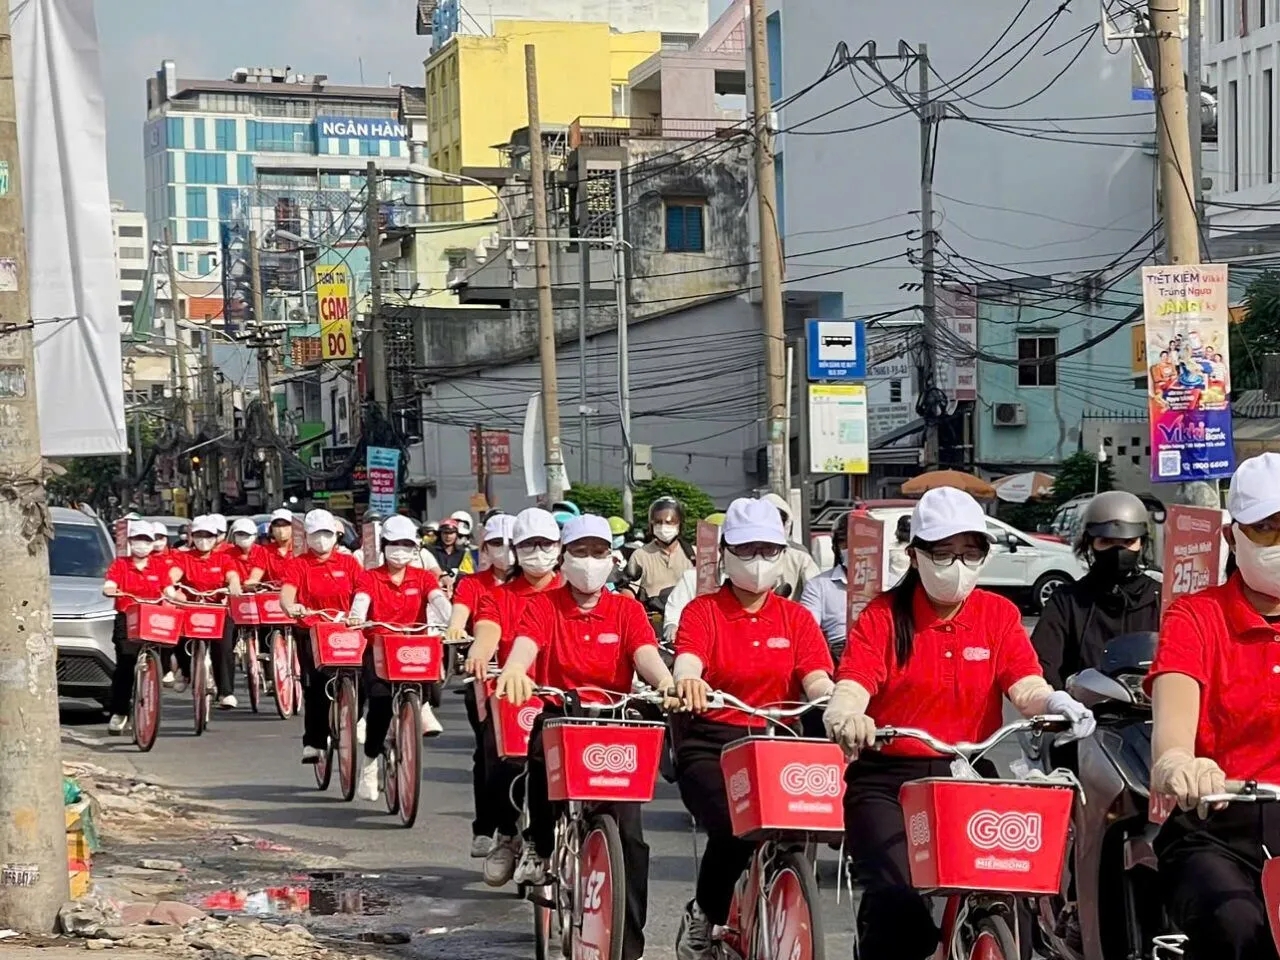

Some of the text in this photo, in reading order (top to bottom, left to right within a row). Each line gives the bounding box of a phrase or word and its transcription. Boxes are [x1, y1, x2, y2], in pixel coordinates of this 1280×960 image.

[323, 120, 407, 137] NGÂN HÀN
[328, 324, 347, 356] ĐỒ
[1157, 414, 1205, 443] Vikki
[1205, 431, 1226, 441] Bank
[1172, 562, 1192, 593] 25
[582, 743, 637, 773] GO!
[780, 763, 841, 797] GO!
[967, 809, 1042, 852] GO!
